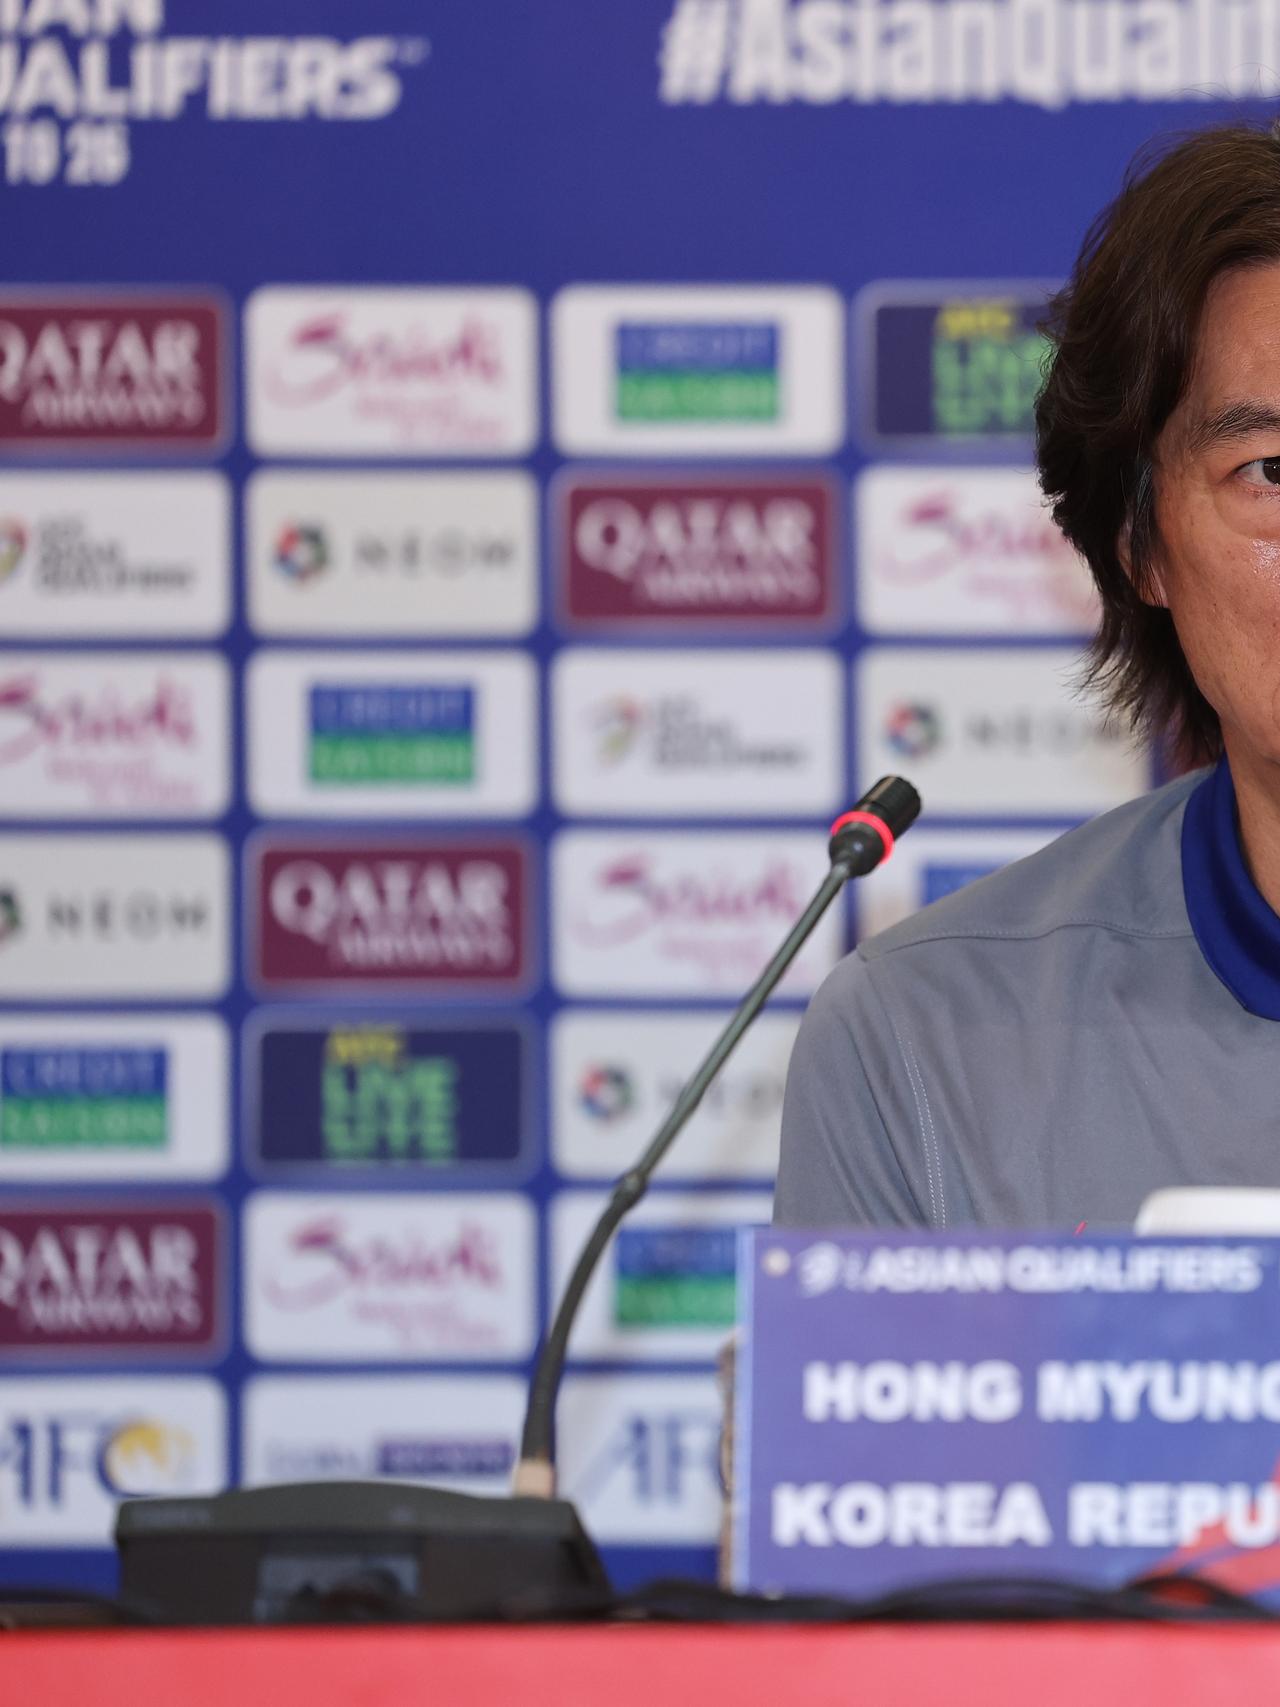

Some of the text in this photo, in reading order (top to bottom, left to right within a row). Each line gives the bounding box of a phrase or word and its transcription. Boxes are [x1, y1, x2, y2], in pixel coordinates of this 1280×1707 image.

[578, 498, 815, 580] QATAR
[270, 862, 510, 938] QATAR
[1005, 1244, 1262, 1293] QUALIFIERS
[803, 1360, 1023, 1423] HONG
[771, 1482, 1051, 1548] KOREA
